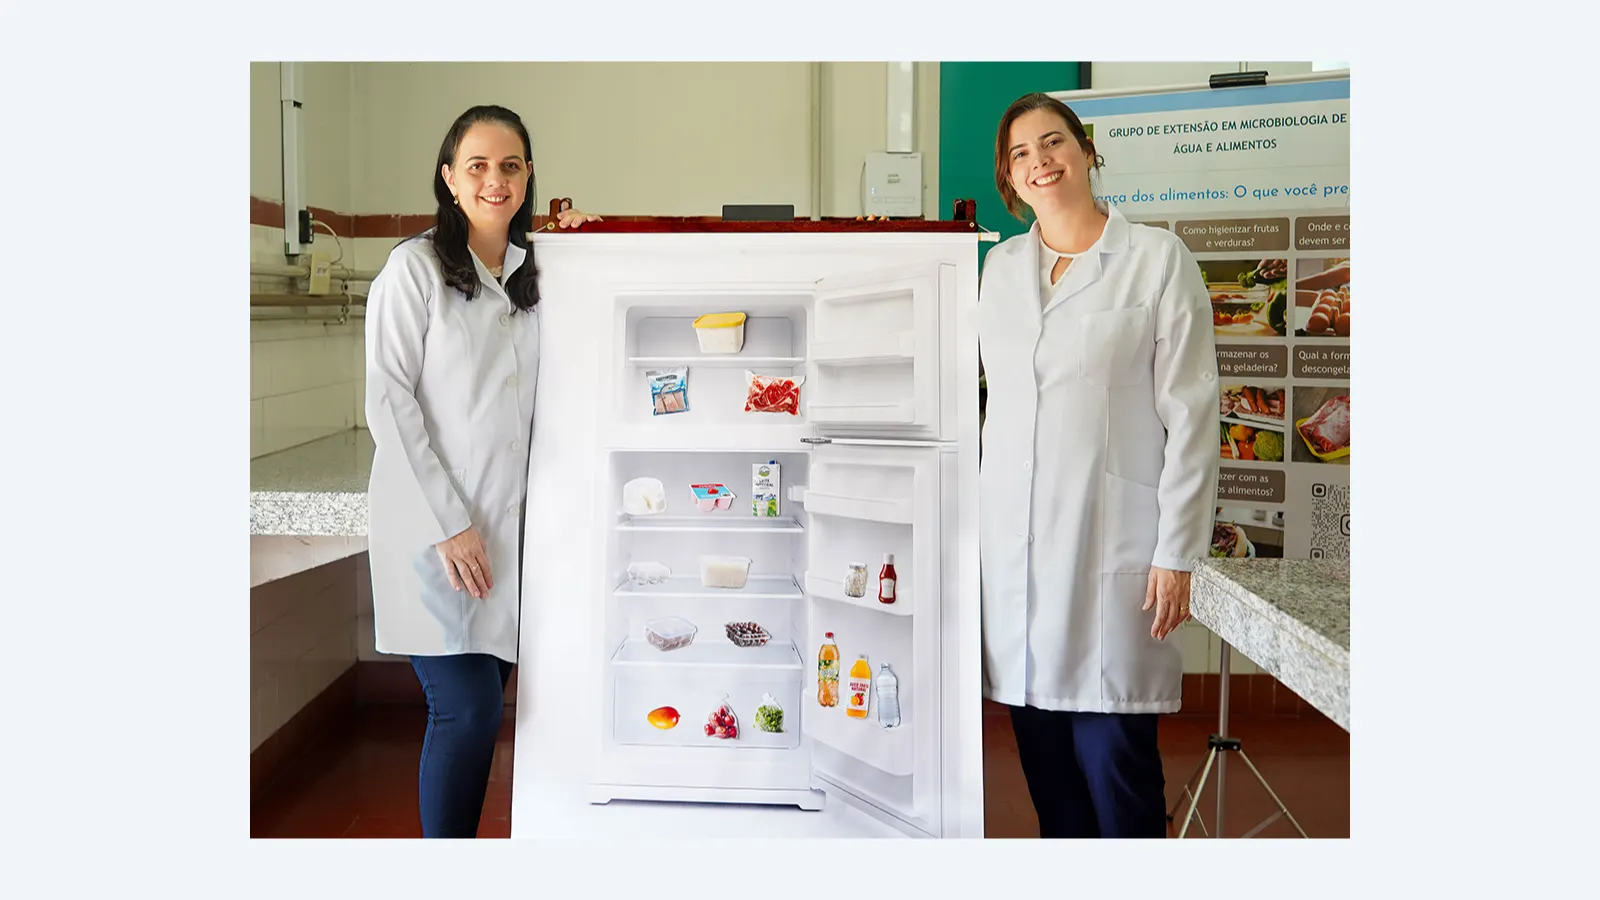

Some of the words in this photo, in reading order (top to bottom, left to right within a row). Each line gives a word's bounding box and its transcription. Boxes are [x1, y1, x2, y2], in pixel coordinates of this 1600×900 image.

[1109, 127, 1144, 138] GRUPO
[1147, 126, 1160, 135] DE
[1163, 121, 1218, 134] EXTENSÃO
[1222, 121, 1237, 131] EM
[1240, 114, 1328, 129] MICROBIOLOGIA
[1332, 113, 1347, 123] DE
[1173, 143, 1202, 154] ÁGUA
[1206, 142, 1212, 152] E
[1216, 139, 1277, 152] ALIMENTOS
[1131, 189, 1154, 202] dos
[1160, 188, 1229, 201] alimentos:
[1234, 185, 1247, 198] O
[1252, 188, 1279, 200] que
[1285, 183, 1317, 196] você
[1323, 186, 1349, 197] pre
[1183, 226, 1206, 235] Como
[1209, 224, 1250, 235] higienizar
[1254, 224, 1279, 233] frutas
[1308, 222, 1332, 232] Onde
[1214, 238, 1255, 247] verduras?
[1299, 236, 1330, 245] devem
[1299, 350, 1319, 360] Qual
[1234, 363, 1278, 373] geladeira?
[1228, 486, 1274, 496] alimentos?
